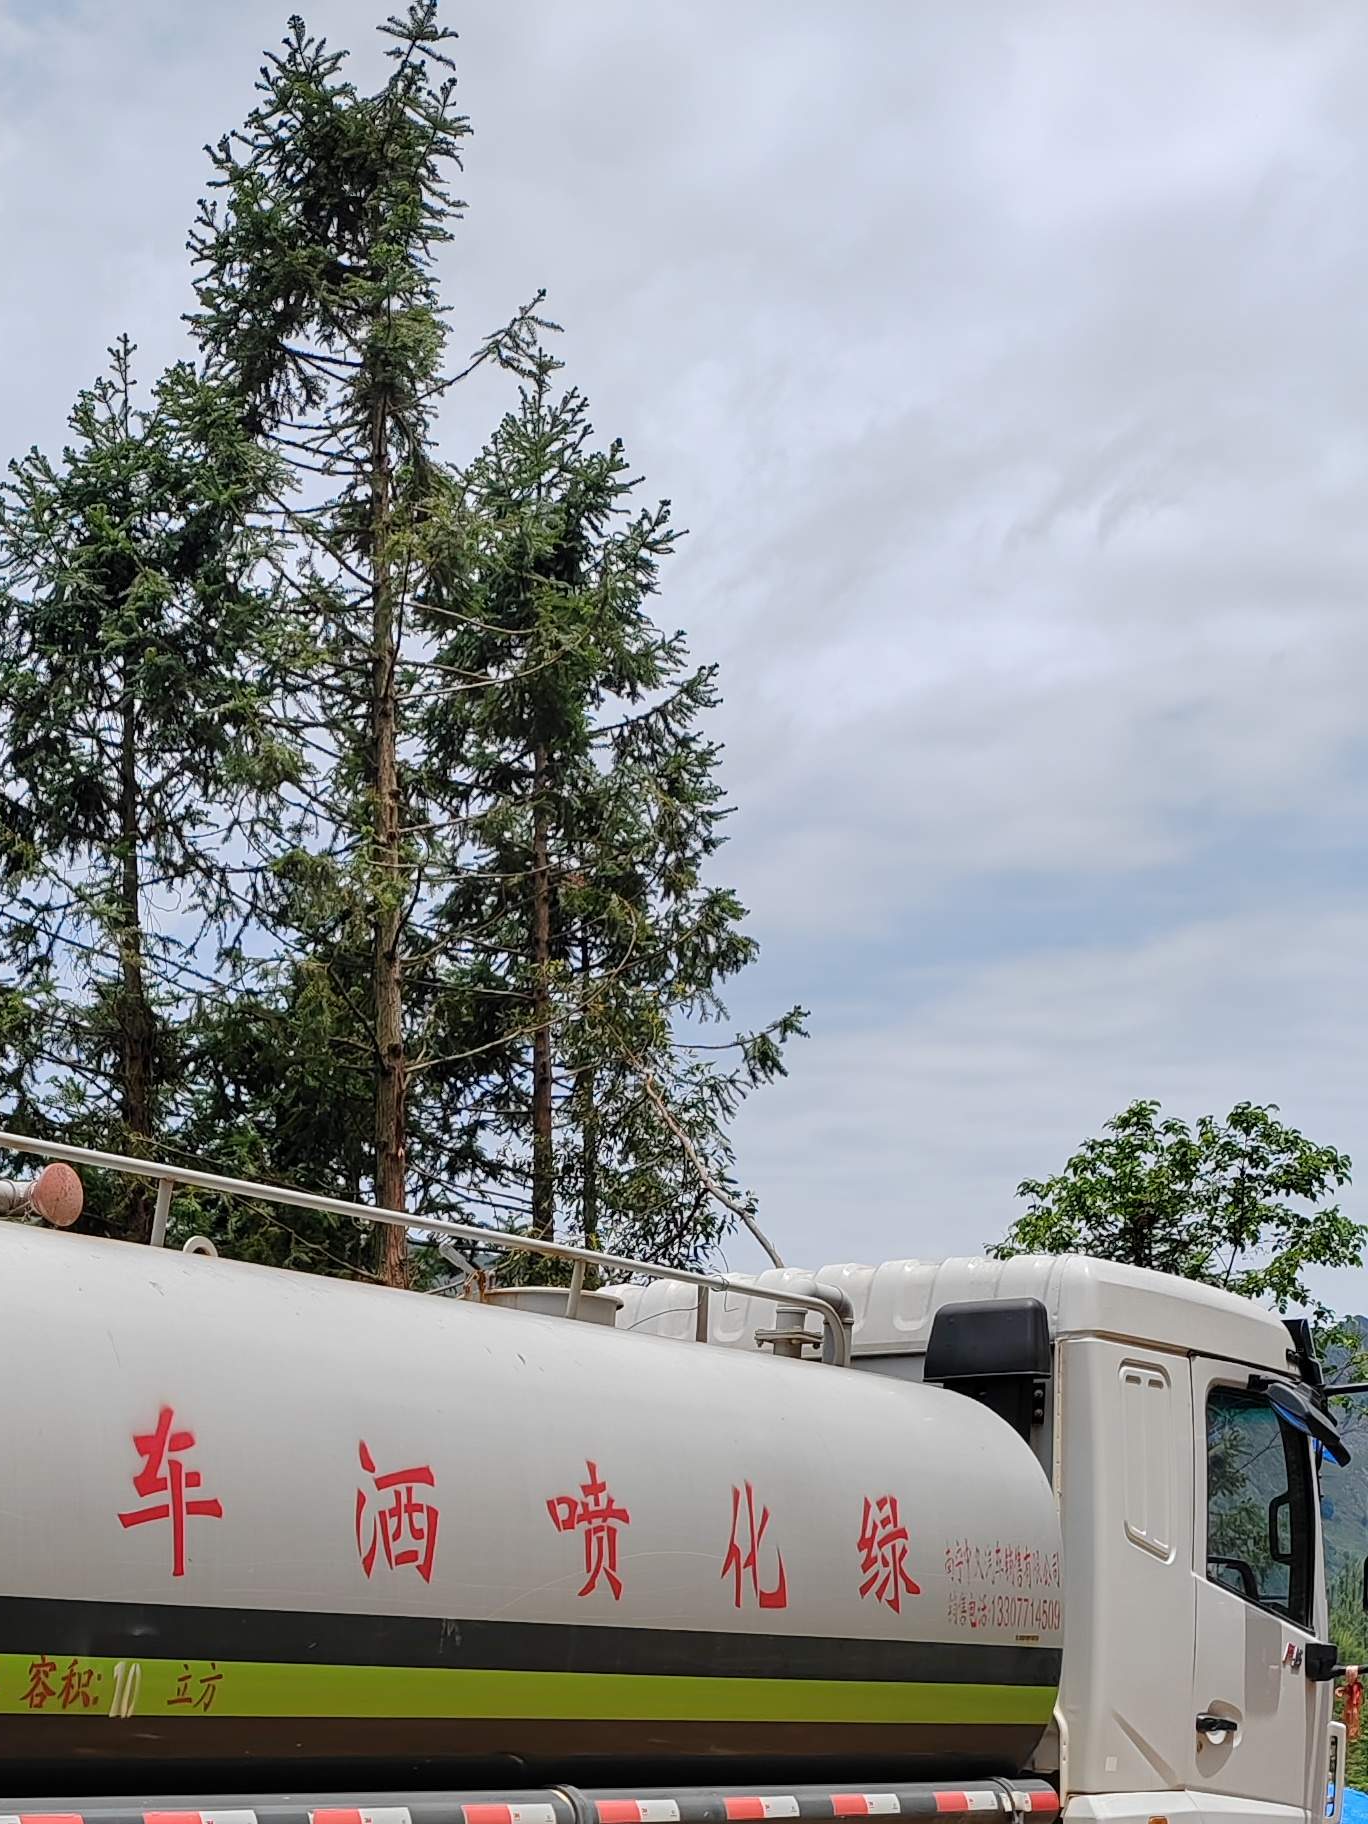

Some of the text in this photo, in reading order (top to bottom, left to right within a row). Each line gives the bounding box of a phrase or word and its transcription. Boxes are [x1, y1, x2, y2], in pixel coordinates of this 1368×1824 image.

[117, 1403, 922, 1615] 车 洒 喷 化 绿
